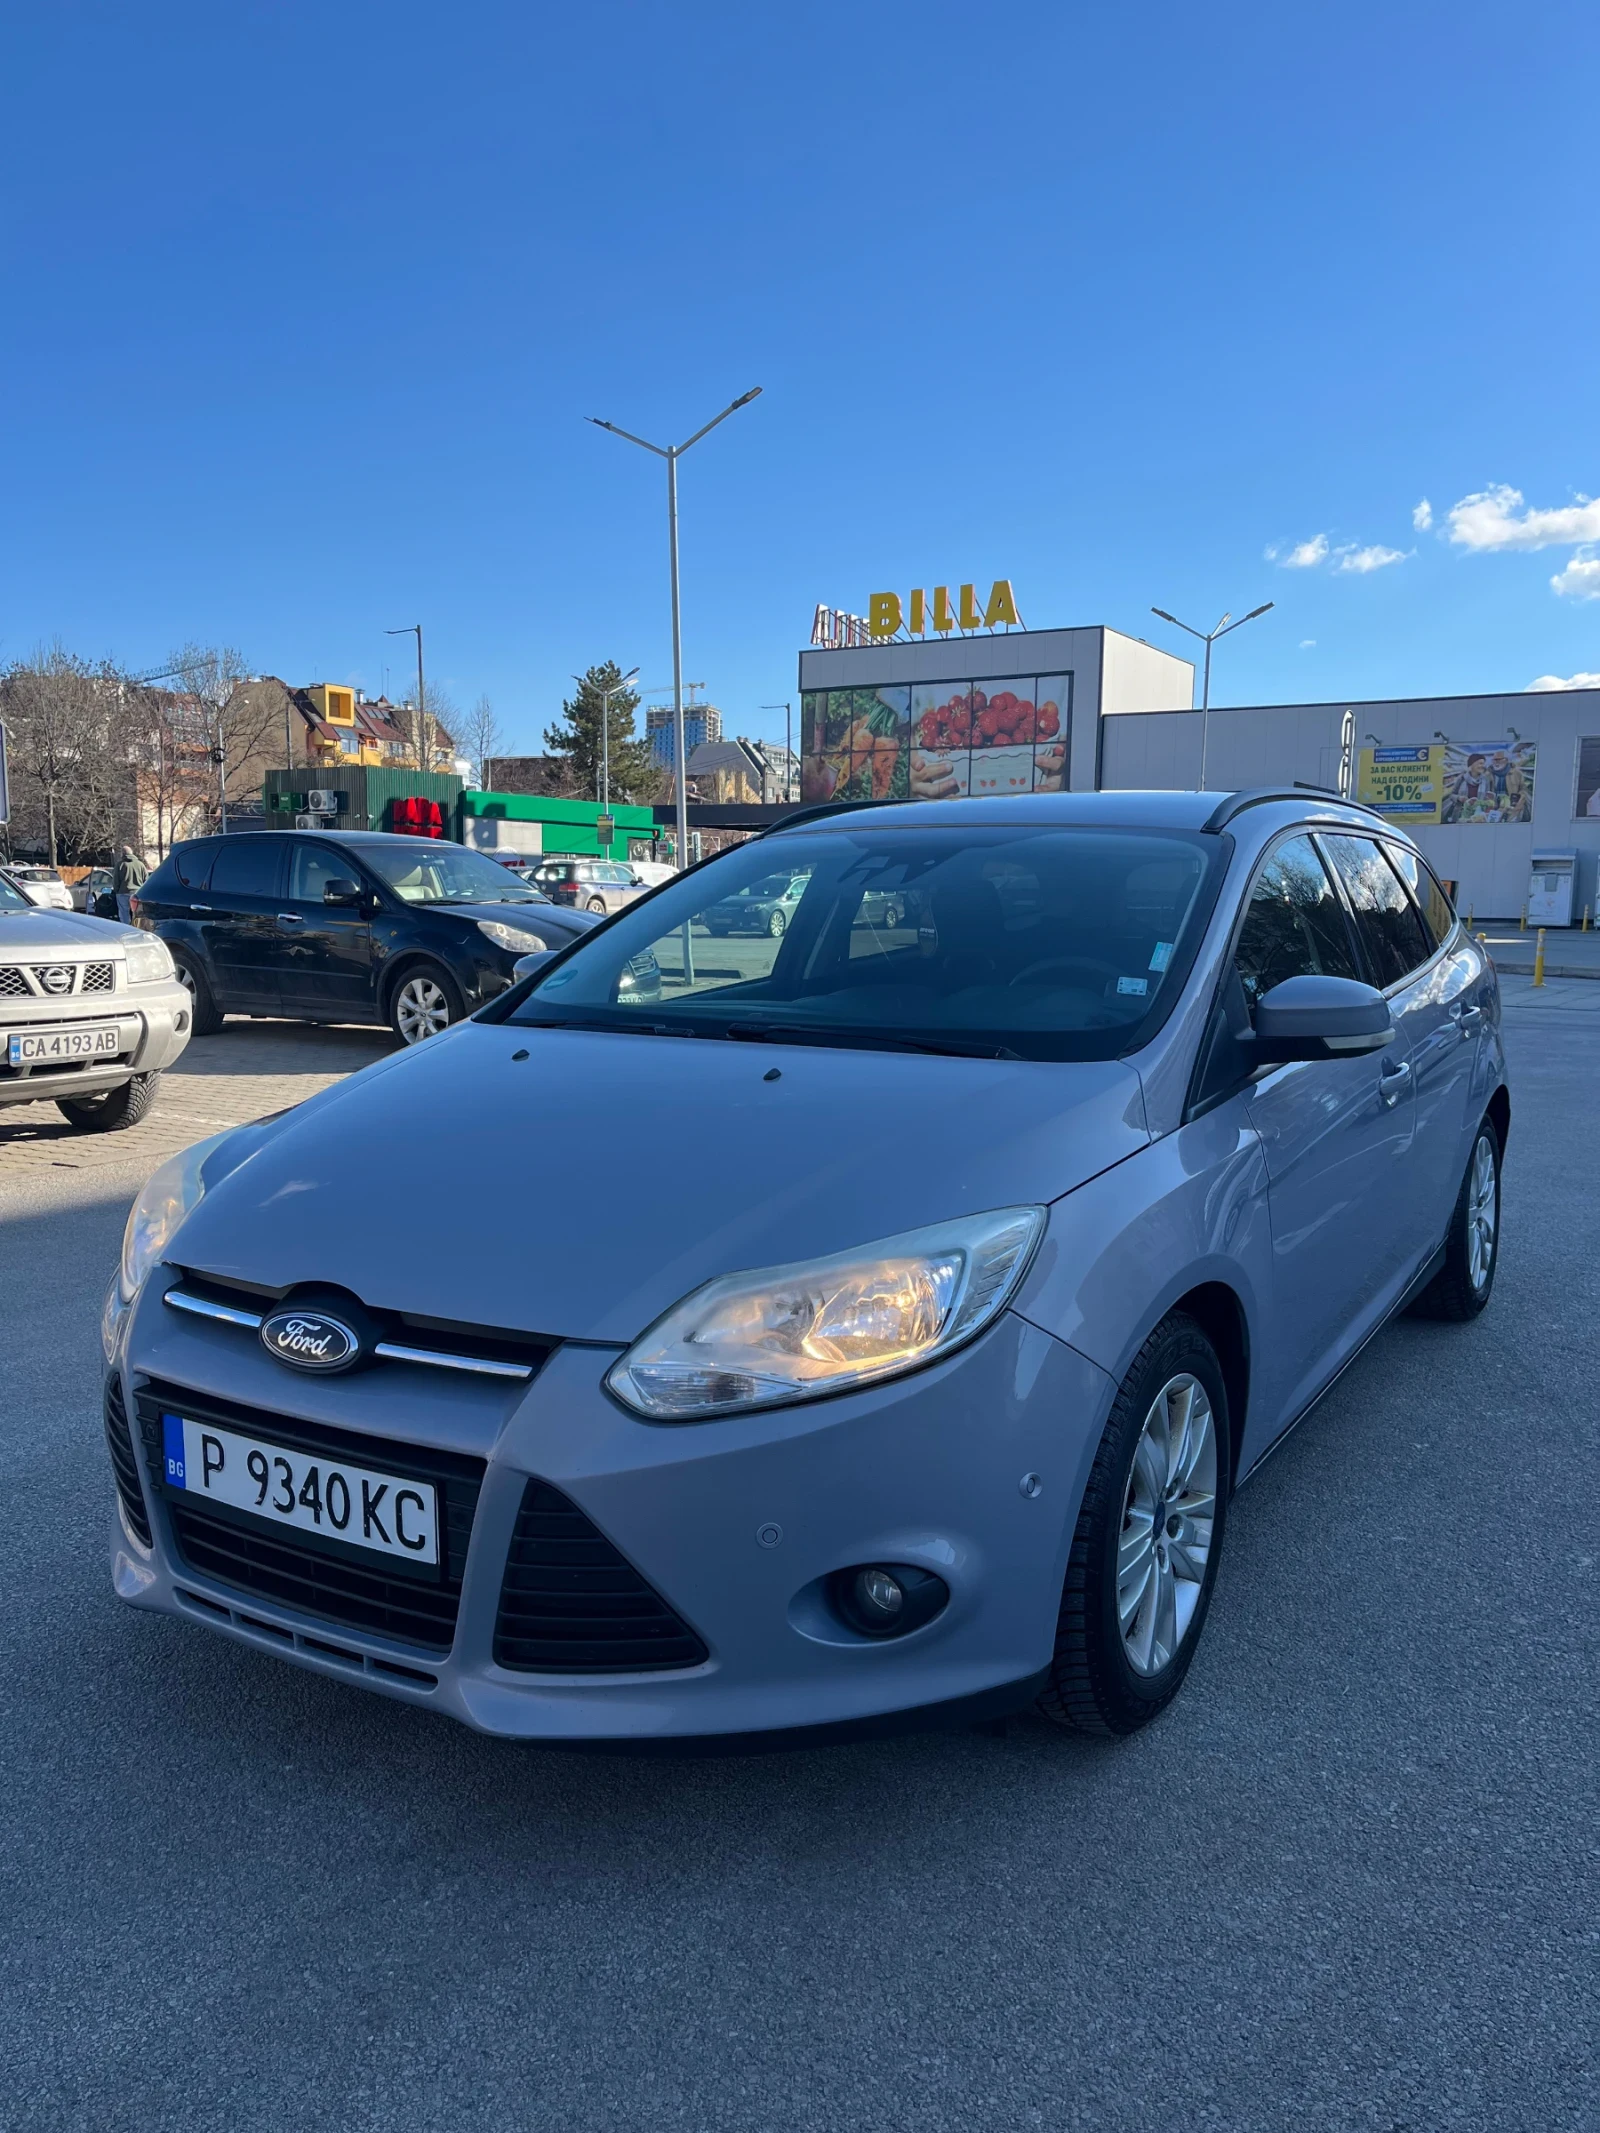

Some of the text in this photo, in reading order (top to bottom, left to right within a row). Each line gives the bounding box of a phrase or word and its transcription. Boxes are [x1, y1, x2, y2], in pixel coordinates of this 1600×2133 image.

[870, 580, 1019, 636] BILLA
[1396, 765, 1431, 773] КЛИЕНТИ
[1398, 776, 1429, 784] ГОДИНИ
[1377, 784, 1422, 800] -10%
[22, 1038, 46, 1057] CA
[50, 1034, 92, 1055] 4193
[95, 1033, 116, 1051] AB
[277, 1319, 332, 1356] Ford
[168, 1433, 426, 1551] BG P 9340 KC
